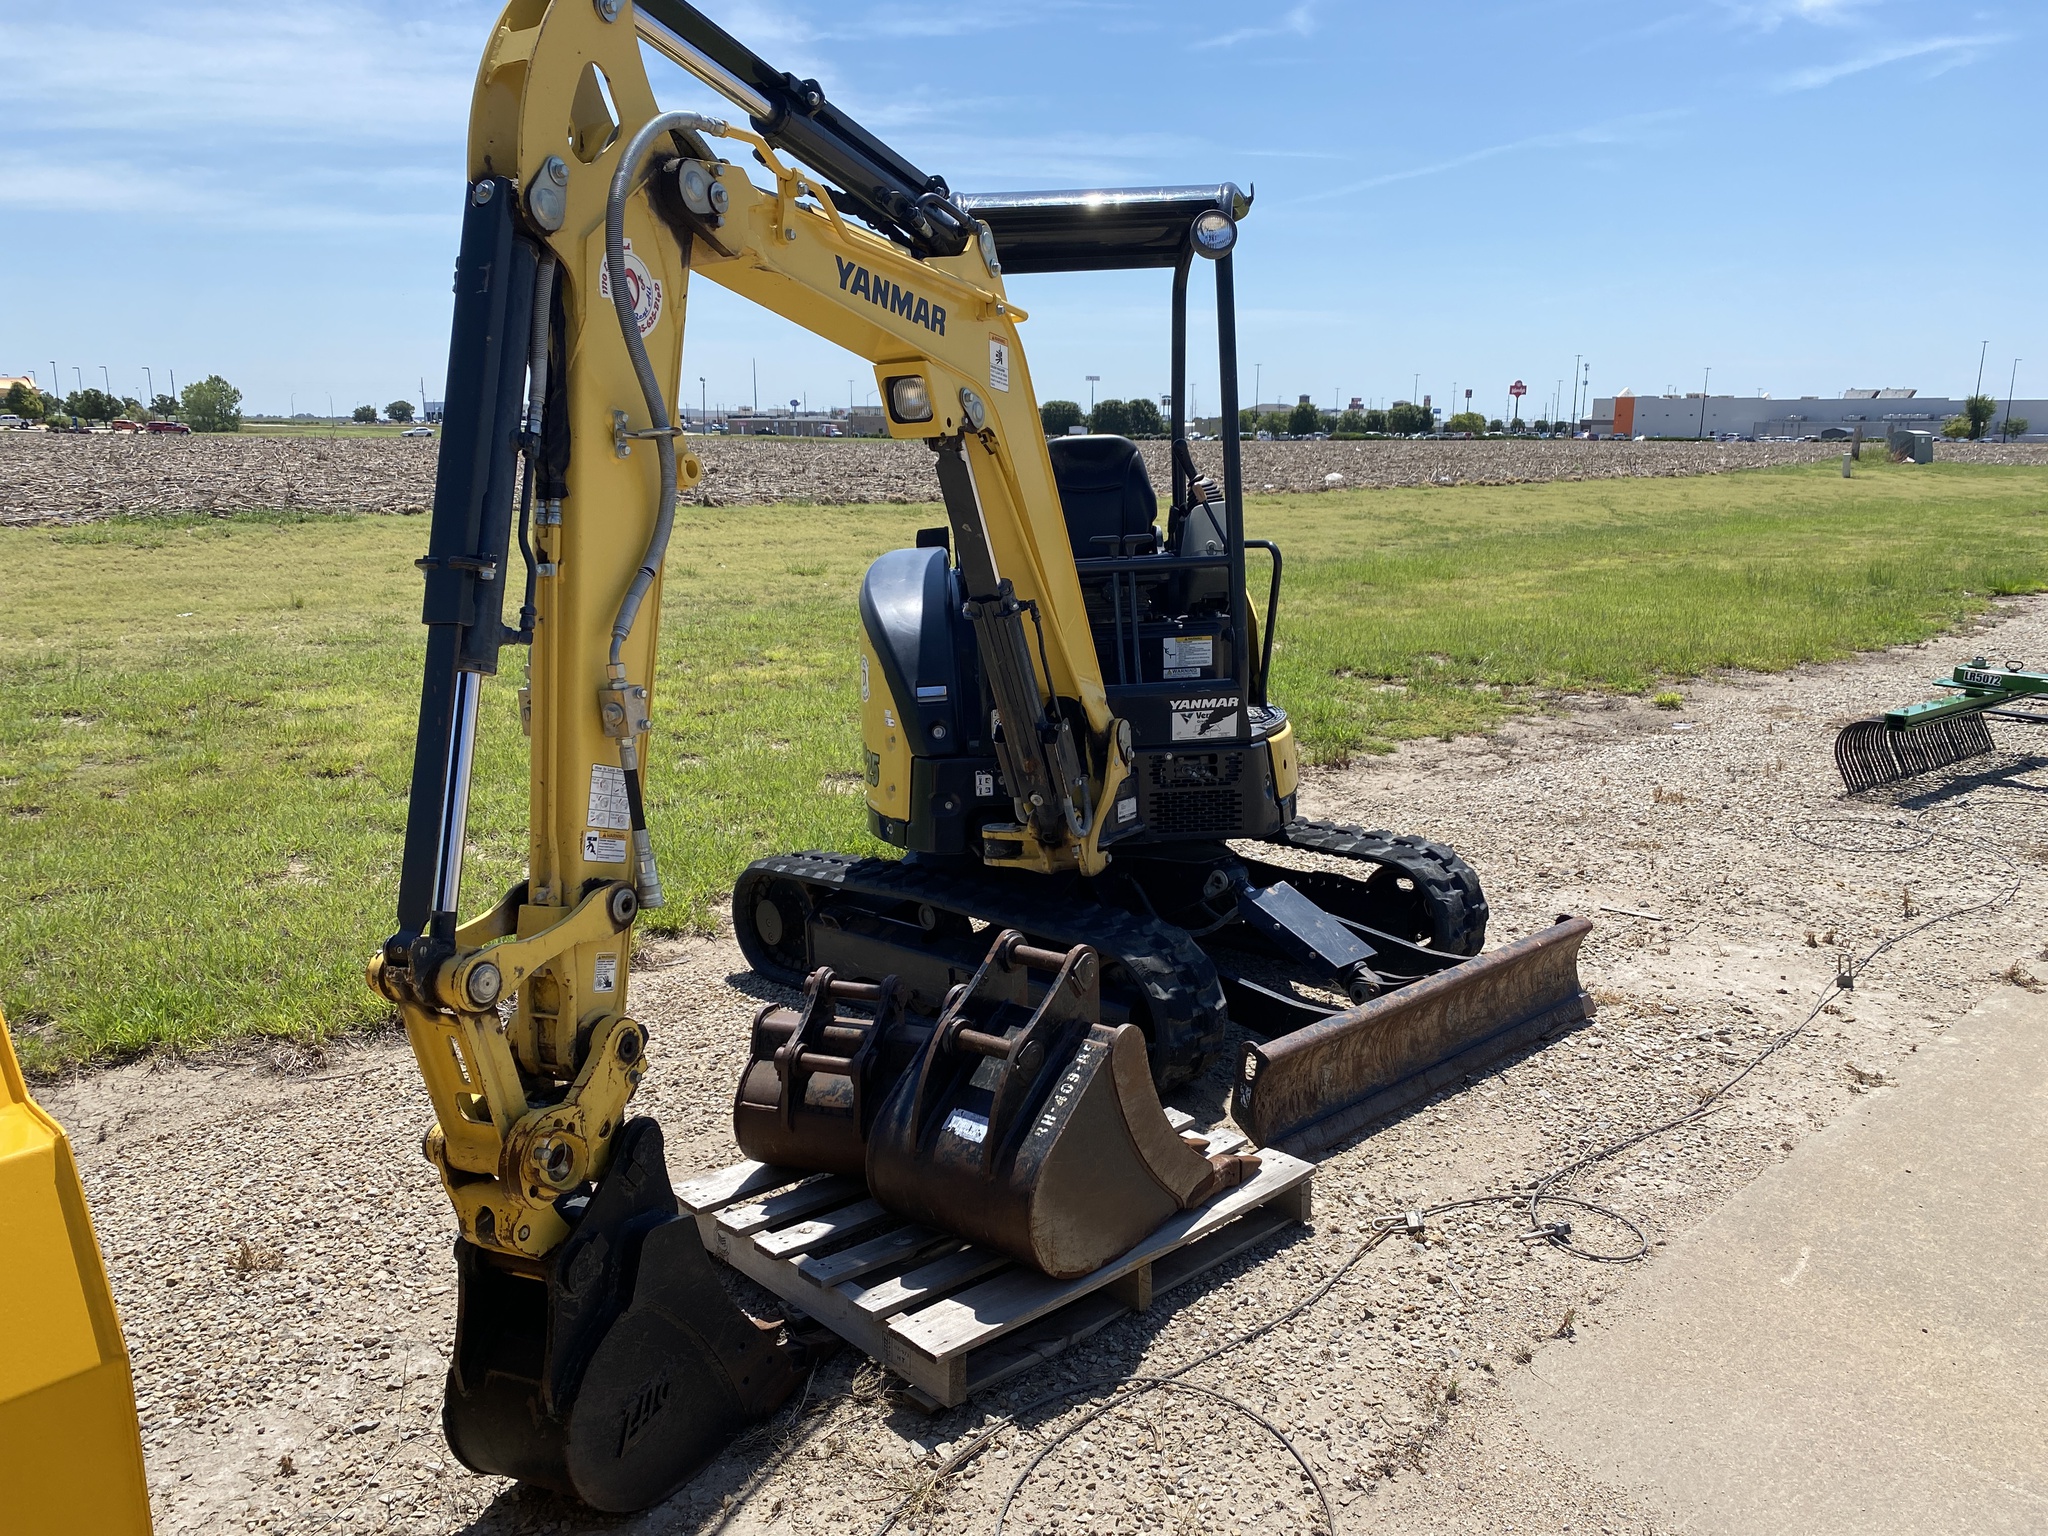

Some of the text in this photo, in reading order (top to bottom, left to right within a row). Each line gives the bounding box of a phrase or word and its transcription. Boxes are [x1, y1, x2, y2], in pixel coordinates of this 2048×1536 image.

[835, 254, 946, 336] YANMAR
[1964, 671, 2002, 685] LR5072
[1169, 697, 1239, 710] YANMAR
